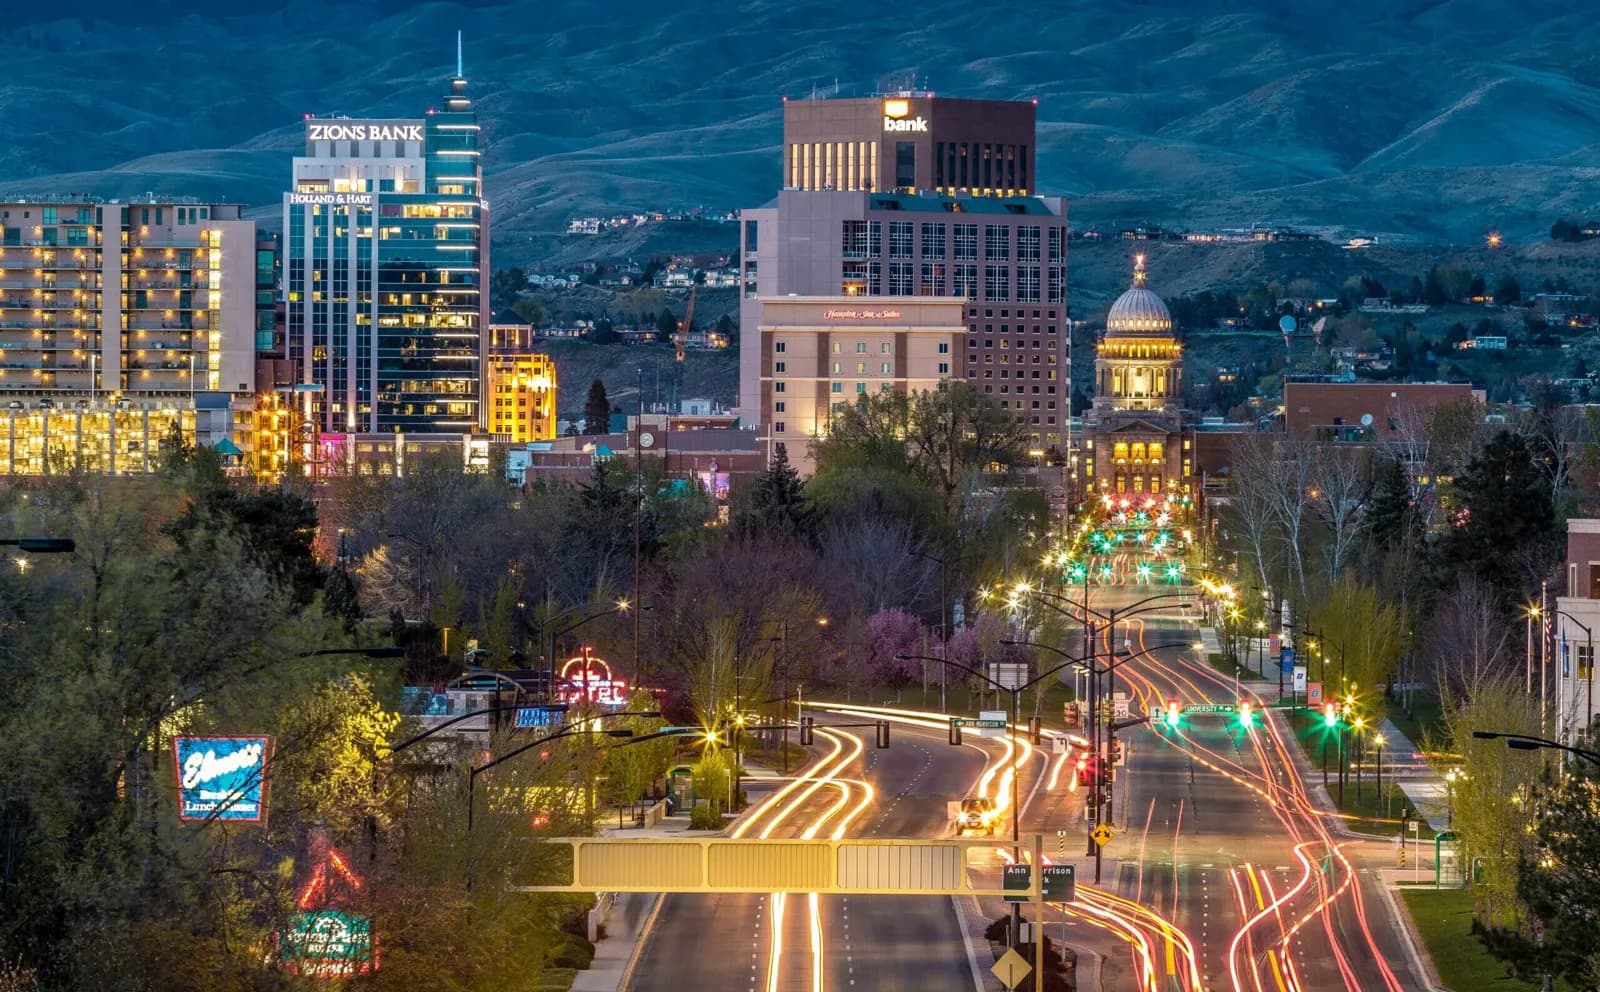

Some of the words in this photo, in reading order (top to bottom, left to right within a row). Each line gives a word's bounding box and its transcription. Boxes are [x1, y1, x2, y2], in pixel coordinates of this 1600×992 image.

[884, 116, 928, 131] bank
[310, 125, 366, 140] ZIONS
[369, 125, 424, 140] BANK
[290, 194, 335, 203] HOLLAND
[337, 194, 345, 203] &
[347, 195, 372, 204] HART
